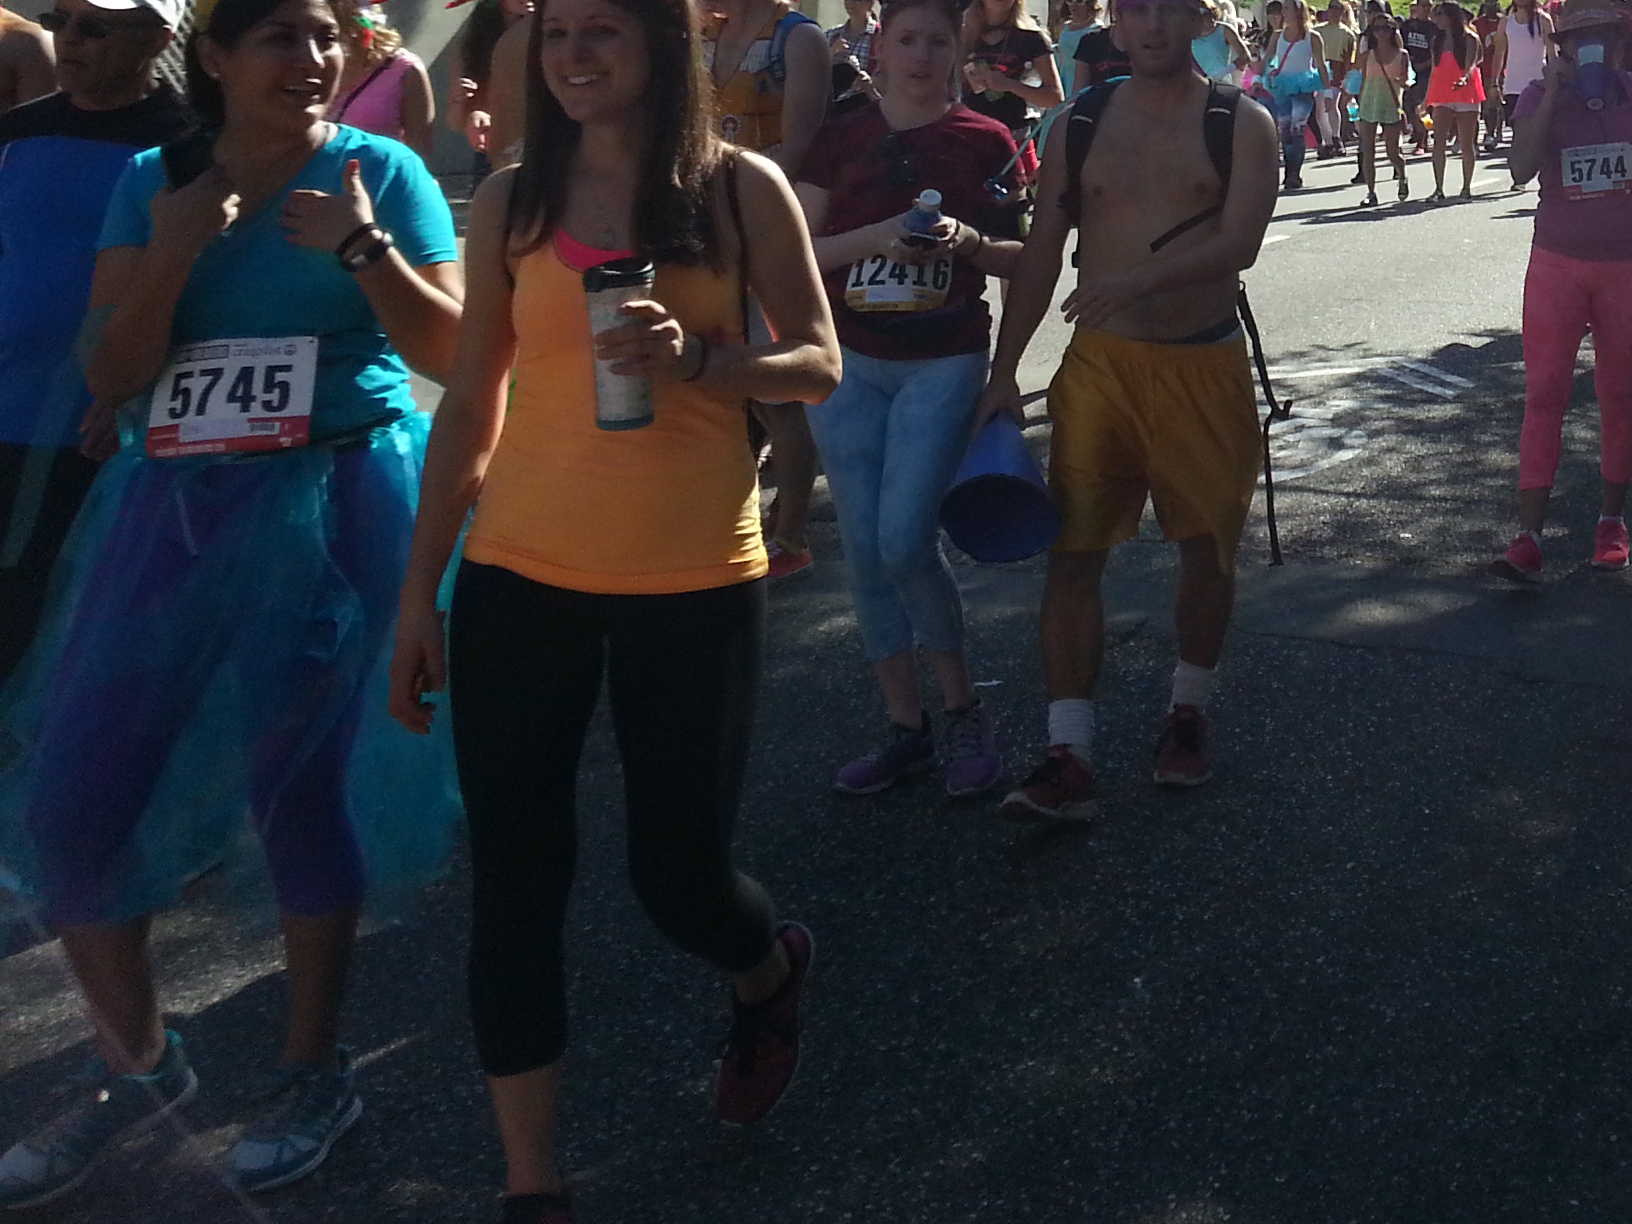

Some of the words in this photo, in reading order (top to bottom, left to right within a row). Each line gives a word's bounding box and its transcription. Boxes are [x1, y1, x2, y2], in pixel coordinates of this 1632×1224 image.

[1570, 156, 1627, 183] 5744
[851, 254, 949, 290] 12416
[168, 364, 293, 419] 5745
